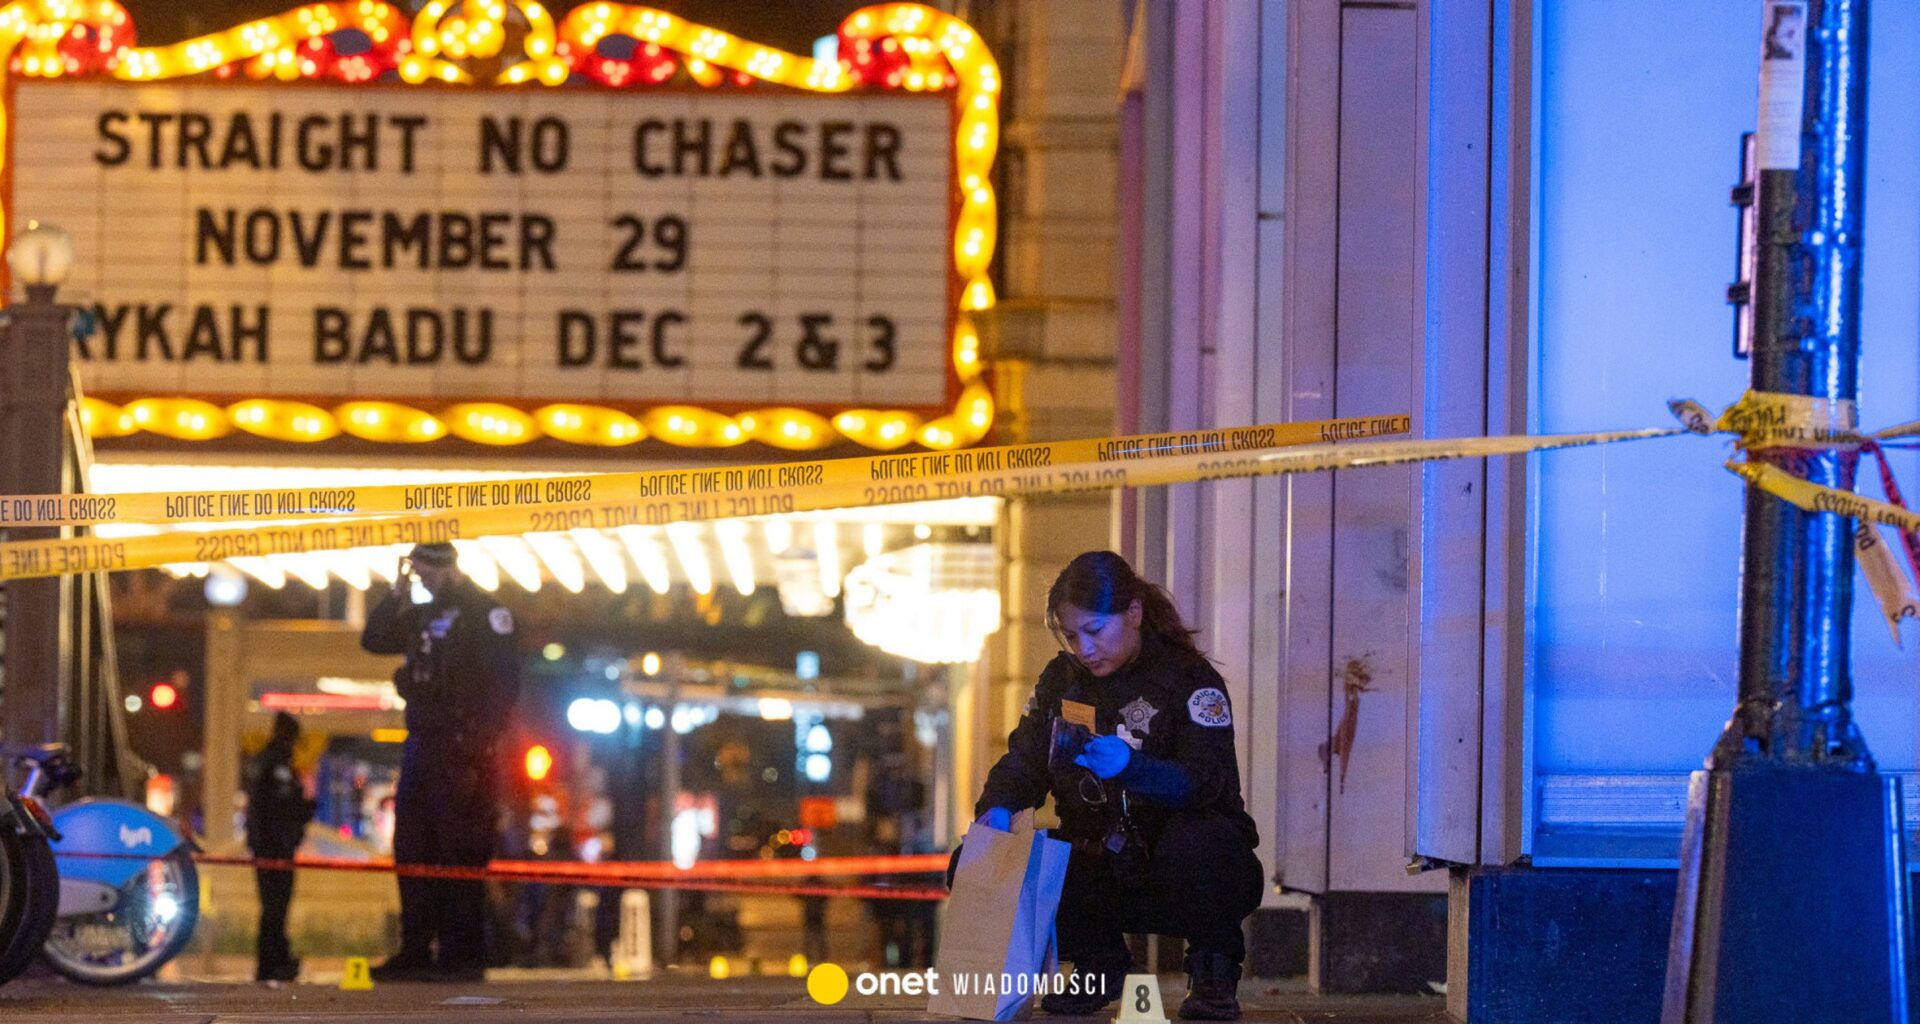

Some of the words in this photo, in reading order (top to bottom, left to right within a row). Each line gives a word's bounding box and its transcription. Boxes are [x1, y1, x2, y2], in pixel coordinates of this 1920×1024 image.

[95, 110, 427, 175] STRAIGHT
[479, 115, 571, 177] NO
[634, 118, 903, 182] CHASER
[195, 208, 556, 271] NOVEMBER
[611, 214, 688, 272] 29
[313, 306, 493, 365] BADU
[558, 310, 688, 369] DEC
[737, 312, 774, 370] 2
[797, 313, 839, 372] &
[867, 315, 897, 372] 3
[1193, 689, 1227, 707] CHICAGO
[1198, 710, 1229, 725] POLICE
[1135, 984, 1151, 1014] 8
